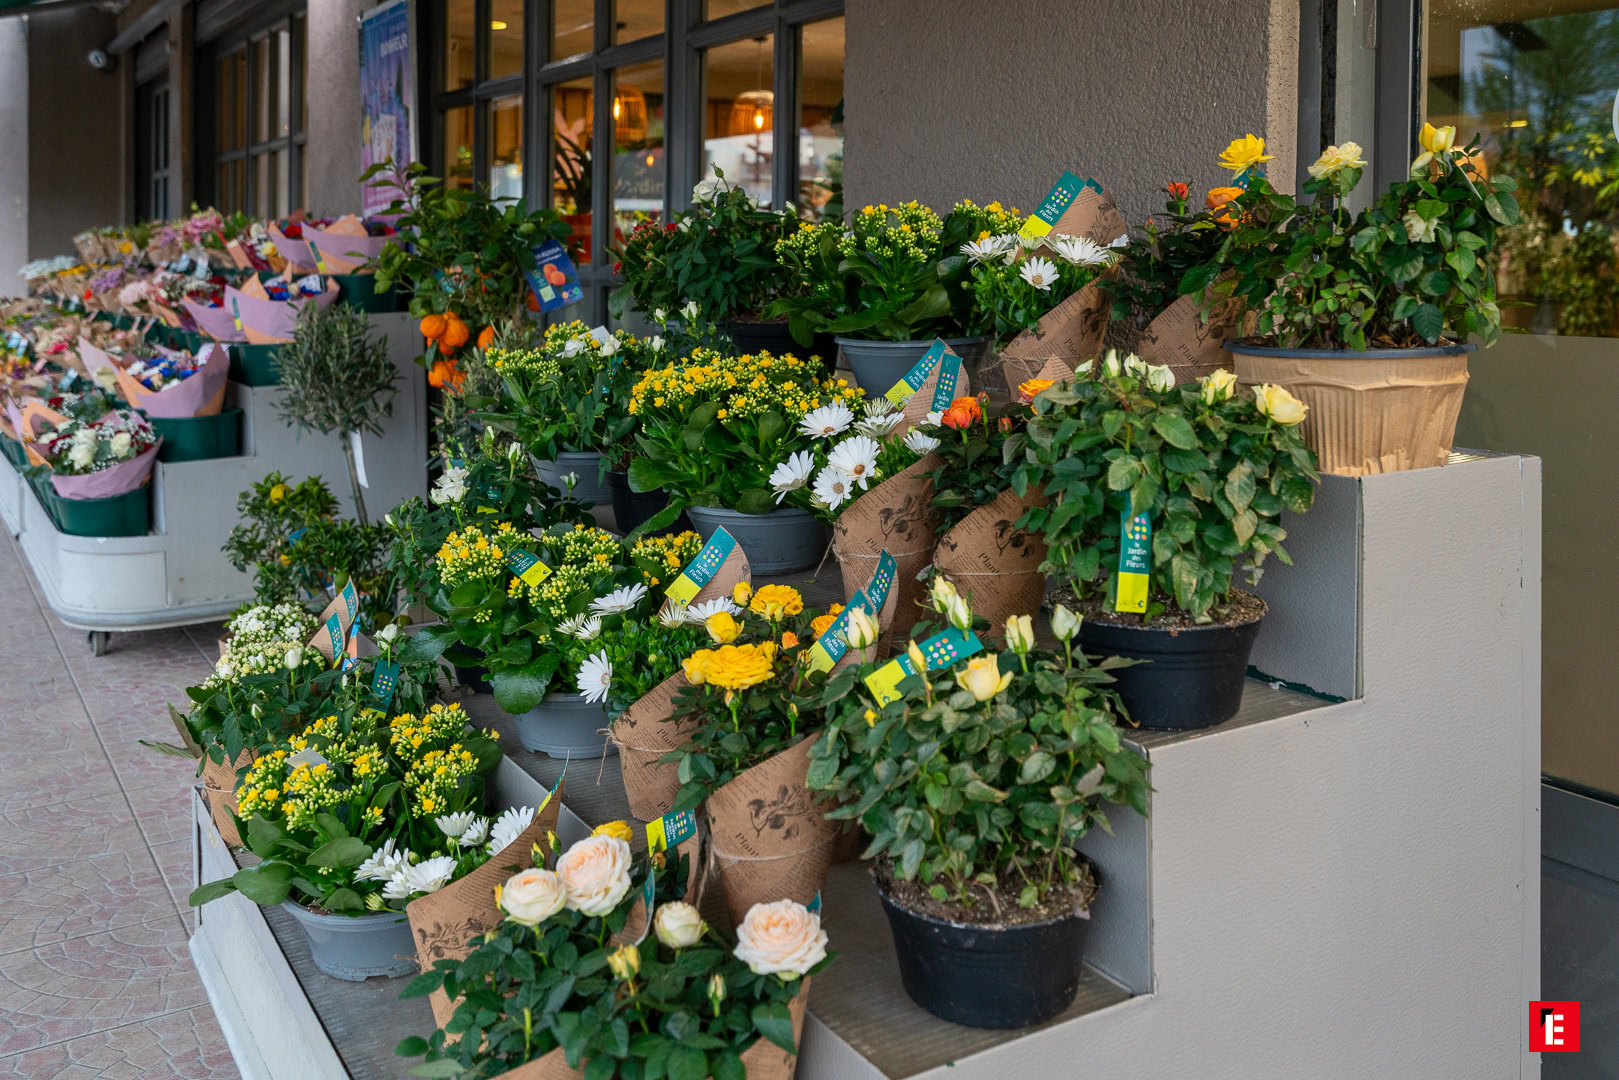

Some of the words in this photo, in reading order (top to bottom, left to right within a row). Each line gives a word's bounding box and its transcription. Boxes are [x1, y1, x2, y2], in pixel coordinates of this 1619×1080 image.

[1126, 560, 1146, 569] Fleurs
[689, 569, 703, 582] Fleurs
[824, 637, 839, 656] Fleurs
[656, 728, 677, 749] Plant
[735, 832, 760, 858] Plant
